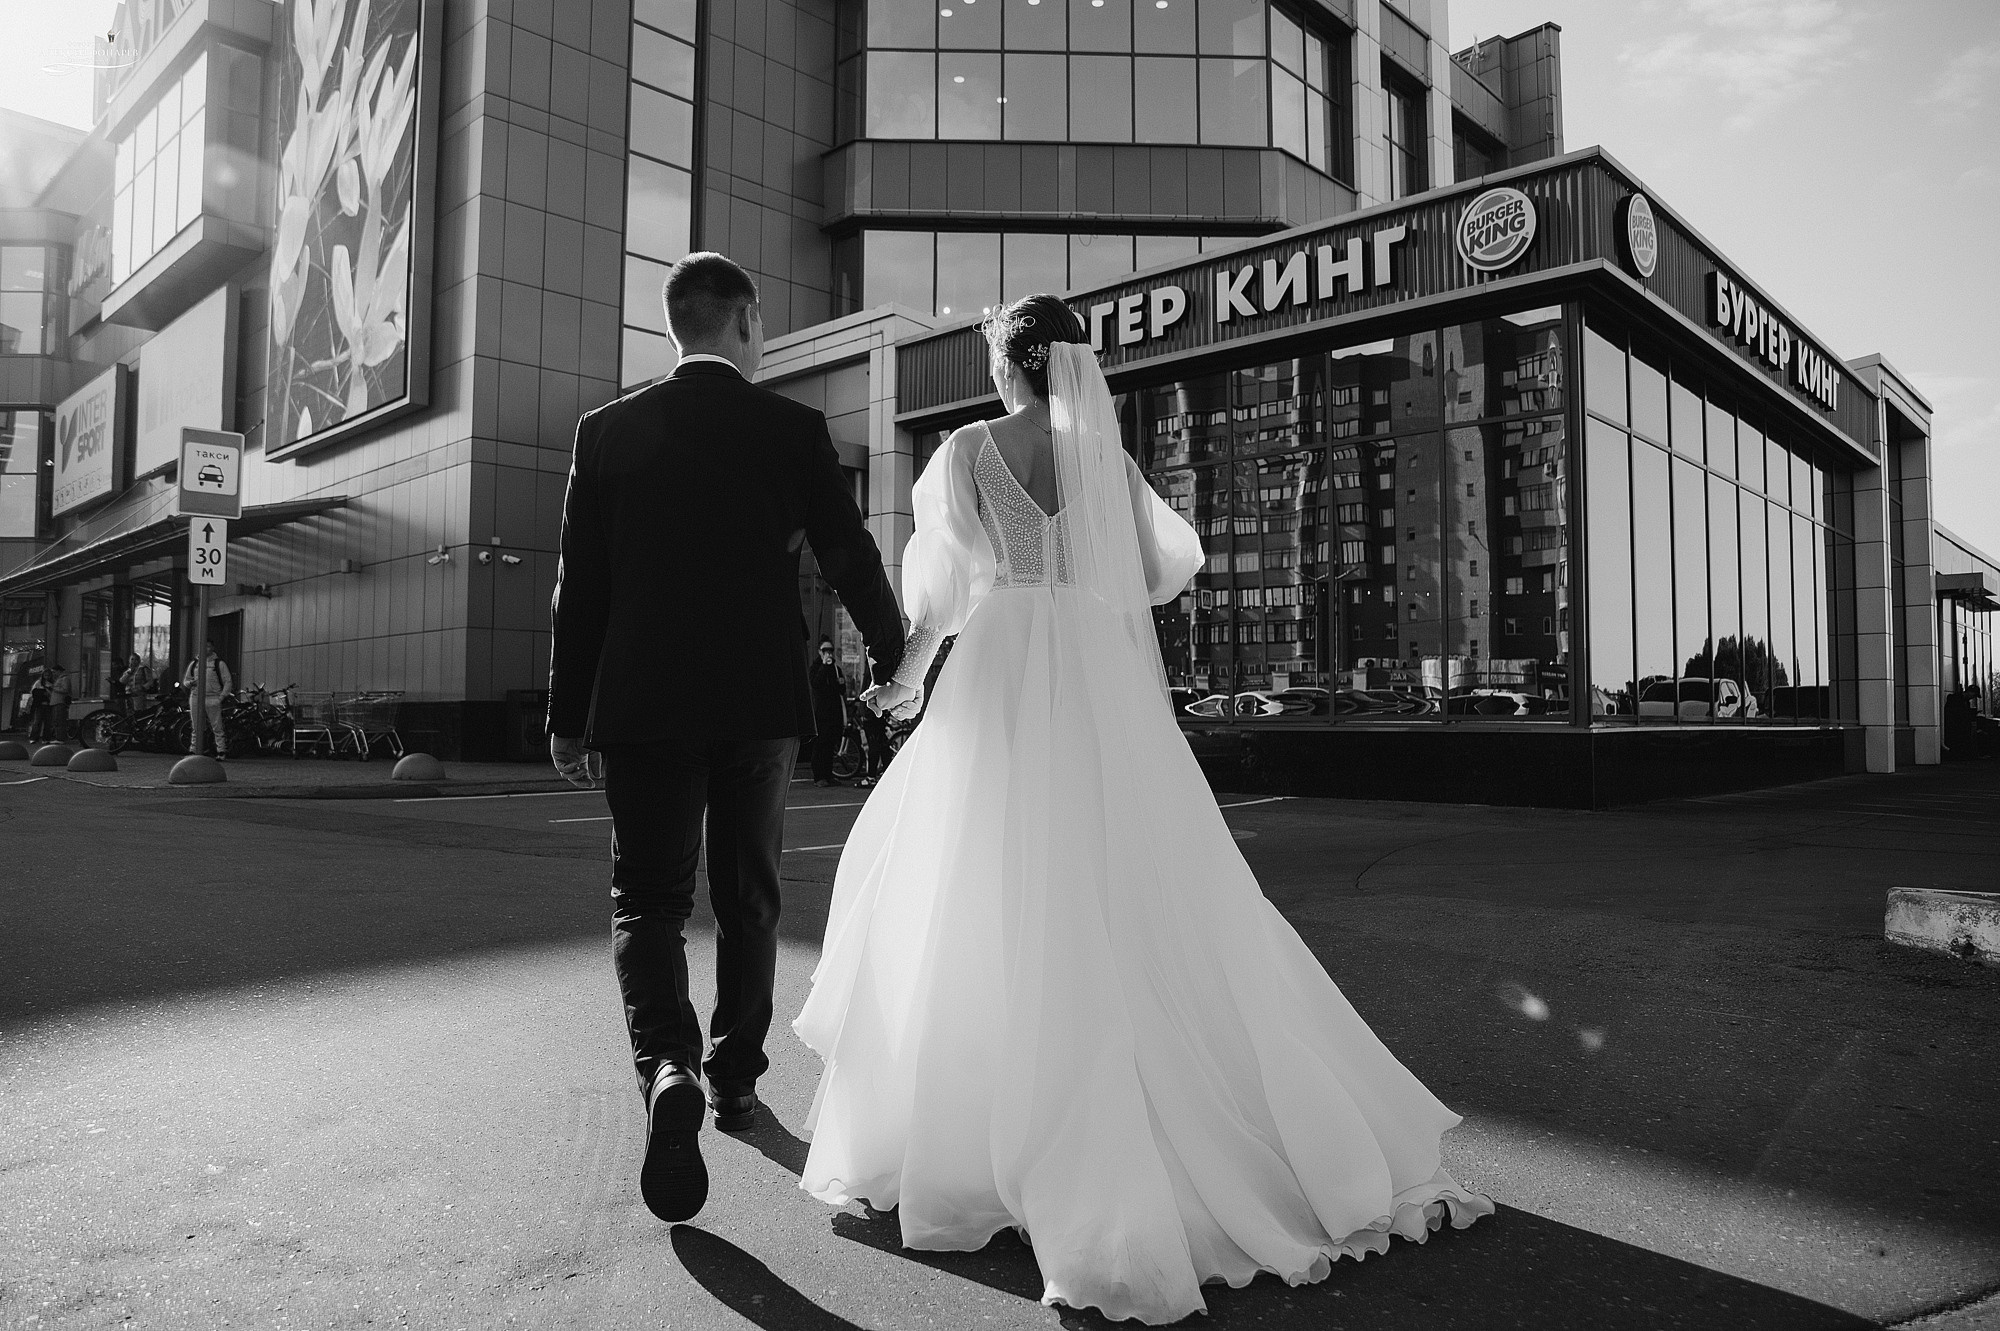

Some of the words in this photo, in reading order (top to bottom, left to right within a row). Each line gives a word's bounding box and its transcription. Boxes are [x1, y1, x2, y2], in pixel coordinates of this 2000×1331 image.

[1467, 199, 1524, 237] BURGER
[1468, 212, 1526, 256] KING
[1632, 214, 1653, 232] BURGER
[1632, 229, 1654, 250] KING
[1216, 225, 1406, 323] КИНГ
[1716, 270, 1791, 371] БУРГЕР
[1797, 339, 1840, 412] КИНГ
[78, 388, 108, 433] INTER
[77, 421, 107, 464] SPORT
[195, 449, 231, 461] такси
[195, 547, 222, 565] 30
